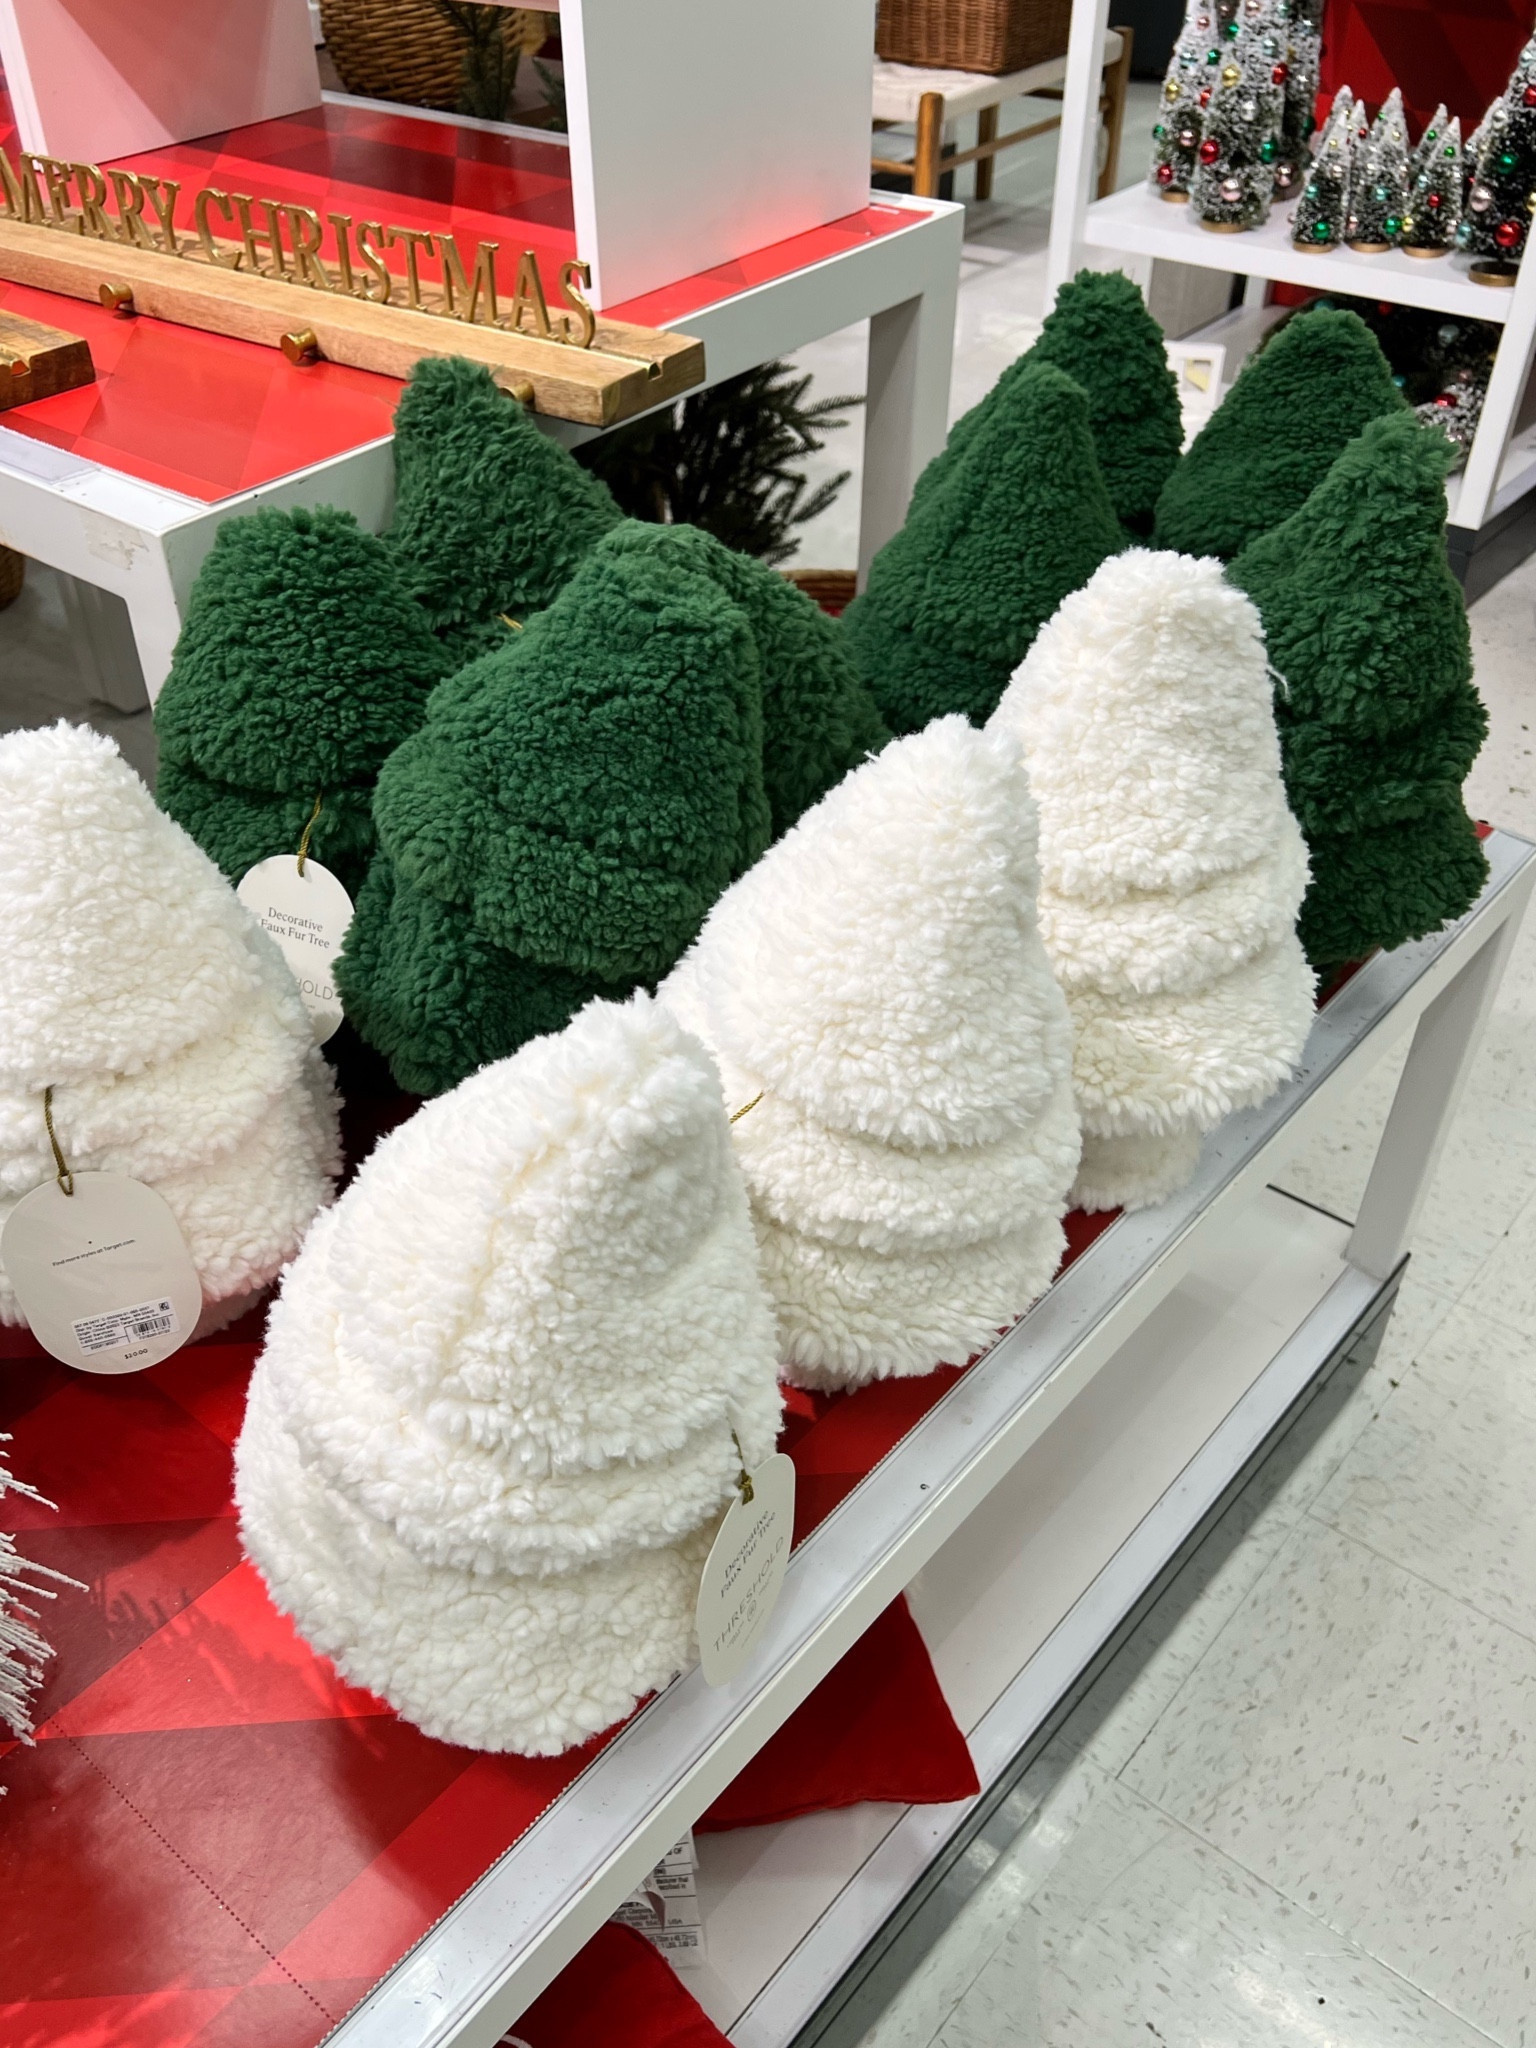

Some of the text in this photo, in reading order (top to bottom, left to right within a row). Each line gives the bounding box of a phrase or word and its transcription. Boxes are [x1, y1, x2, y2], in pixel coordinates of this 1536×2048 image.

[0, 146, 596, 349] MERRY CHRISTMAS
[260, 918, 330, 948] Faux Fur Tree
[268, 906, 324, 932] Decorative
[720, 1566, 742, 1599] Faux
[742, 1539, 758, 1564] Fur
[758, 1511, 776, 1538] Tree
[724, 1509, 768, 1579] Decorative
[713, 1536, 784, 1652] THRESHOLD
